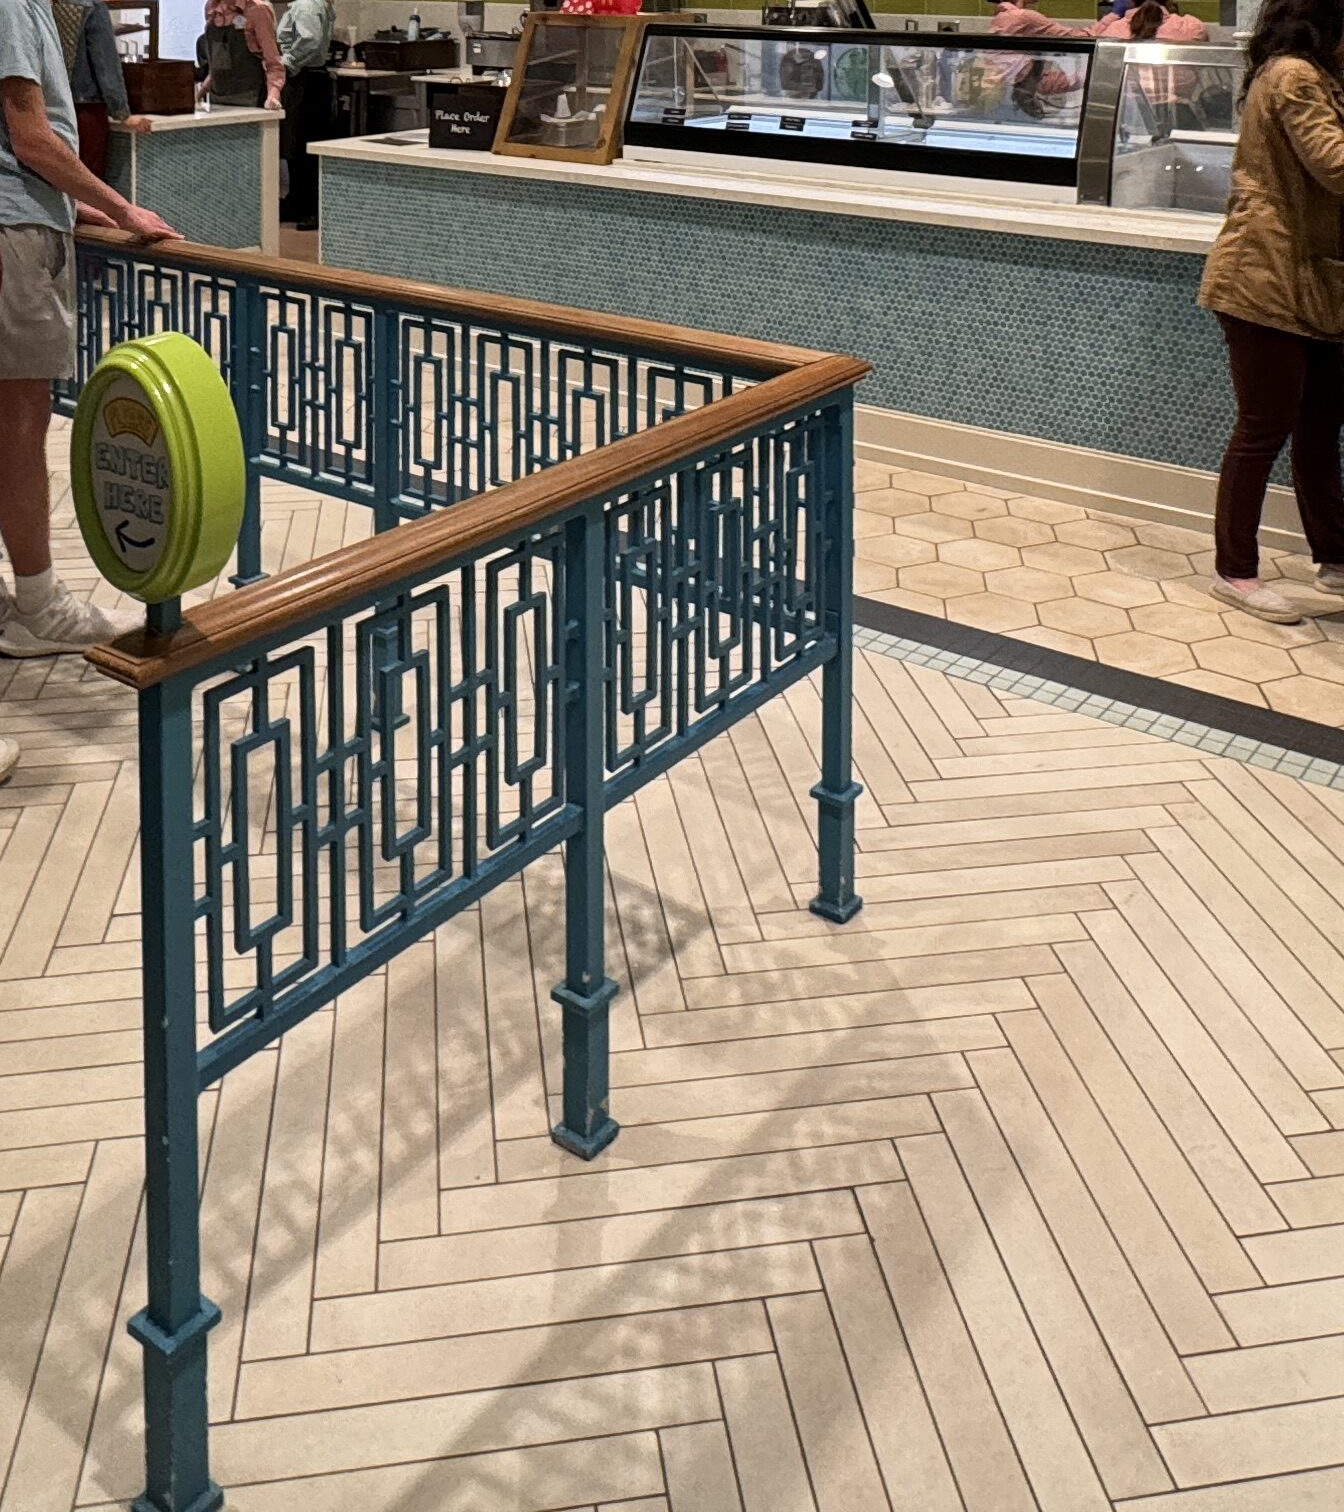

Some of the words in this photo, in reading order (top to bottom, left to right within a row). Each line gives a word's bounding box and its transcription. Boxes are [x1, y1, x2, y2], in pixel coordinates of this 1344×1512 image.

[435, 109, 461, 121] Place
[464, 111, 490, 123] Order
[450, 123, 471, 134] Here
[95, 442, 169, 489] ENTER
[104, 481, 164, 525] HERE
